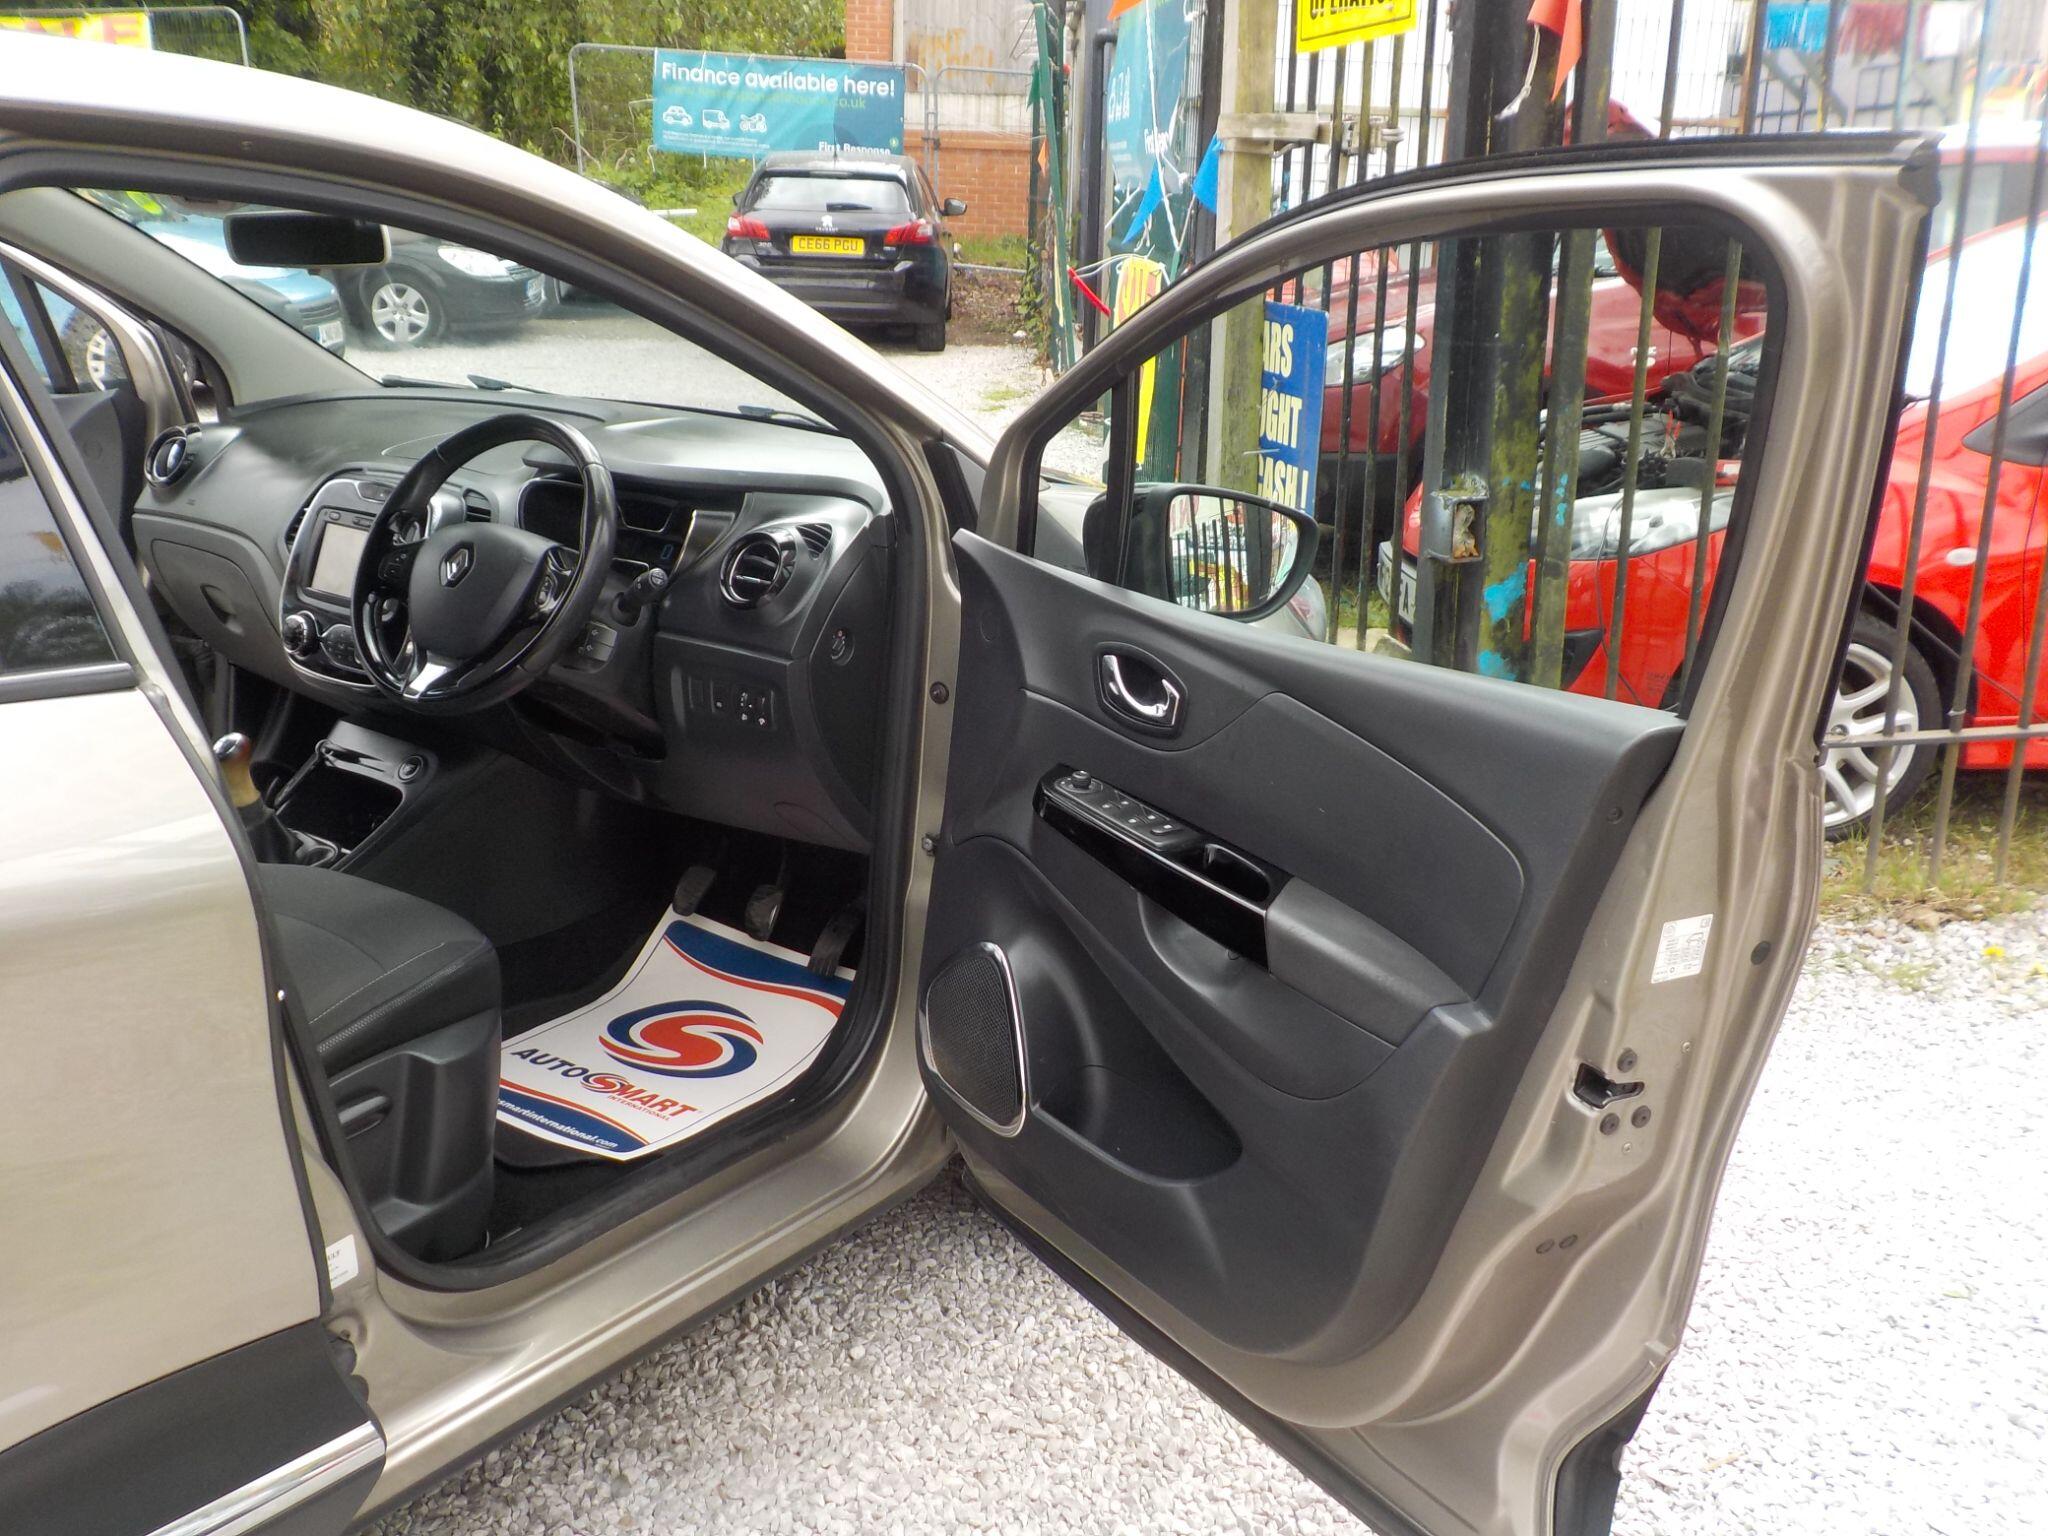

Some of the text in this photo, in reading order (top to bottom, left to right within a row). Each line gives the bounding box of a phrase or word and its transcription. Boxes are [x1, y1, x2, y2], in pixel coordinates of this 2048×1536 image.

[662, 61, 740, 86] Finance
[744, 69, 838, 93] available
[843, 75, 896, 97] here!
[798, 237, 831, 251] CE66
[1263, 320, 1295, 379] ARS
[497, 1098, 619, 1148] smartinternational.com
